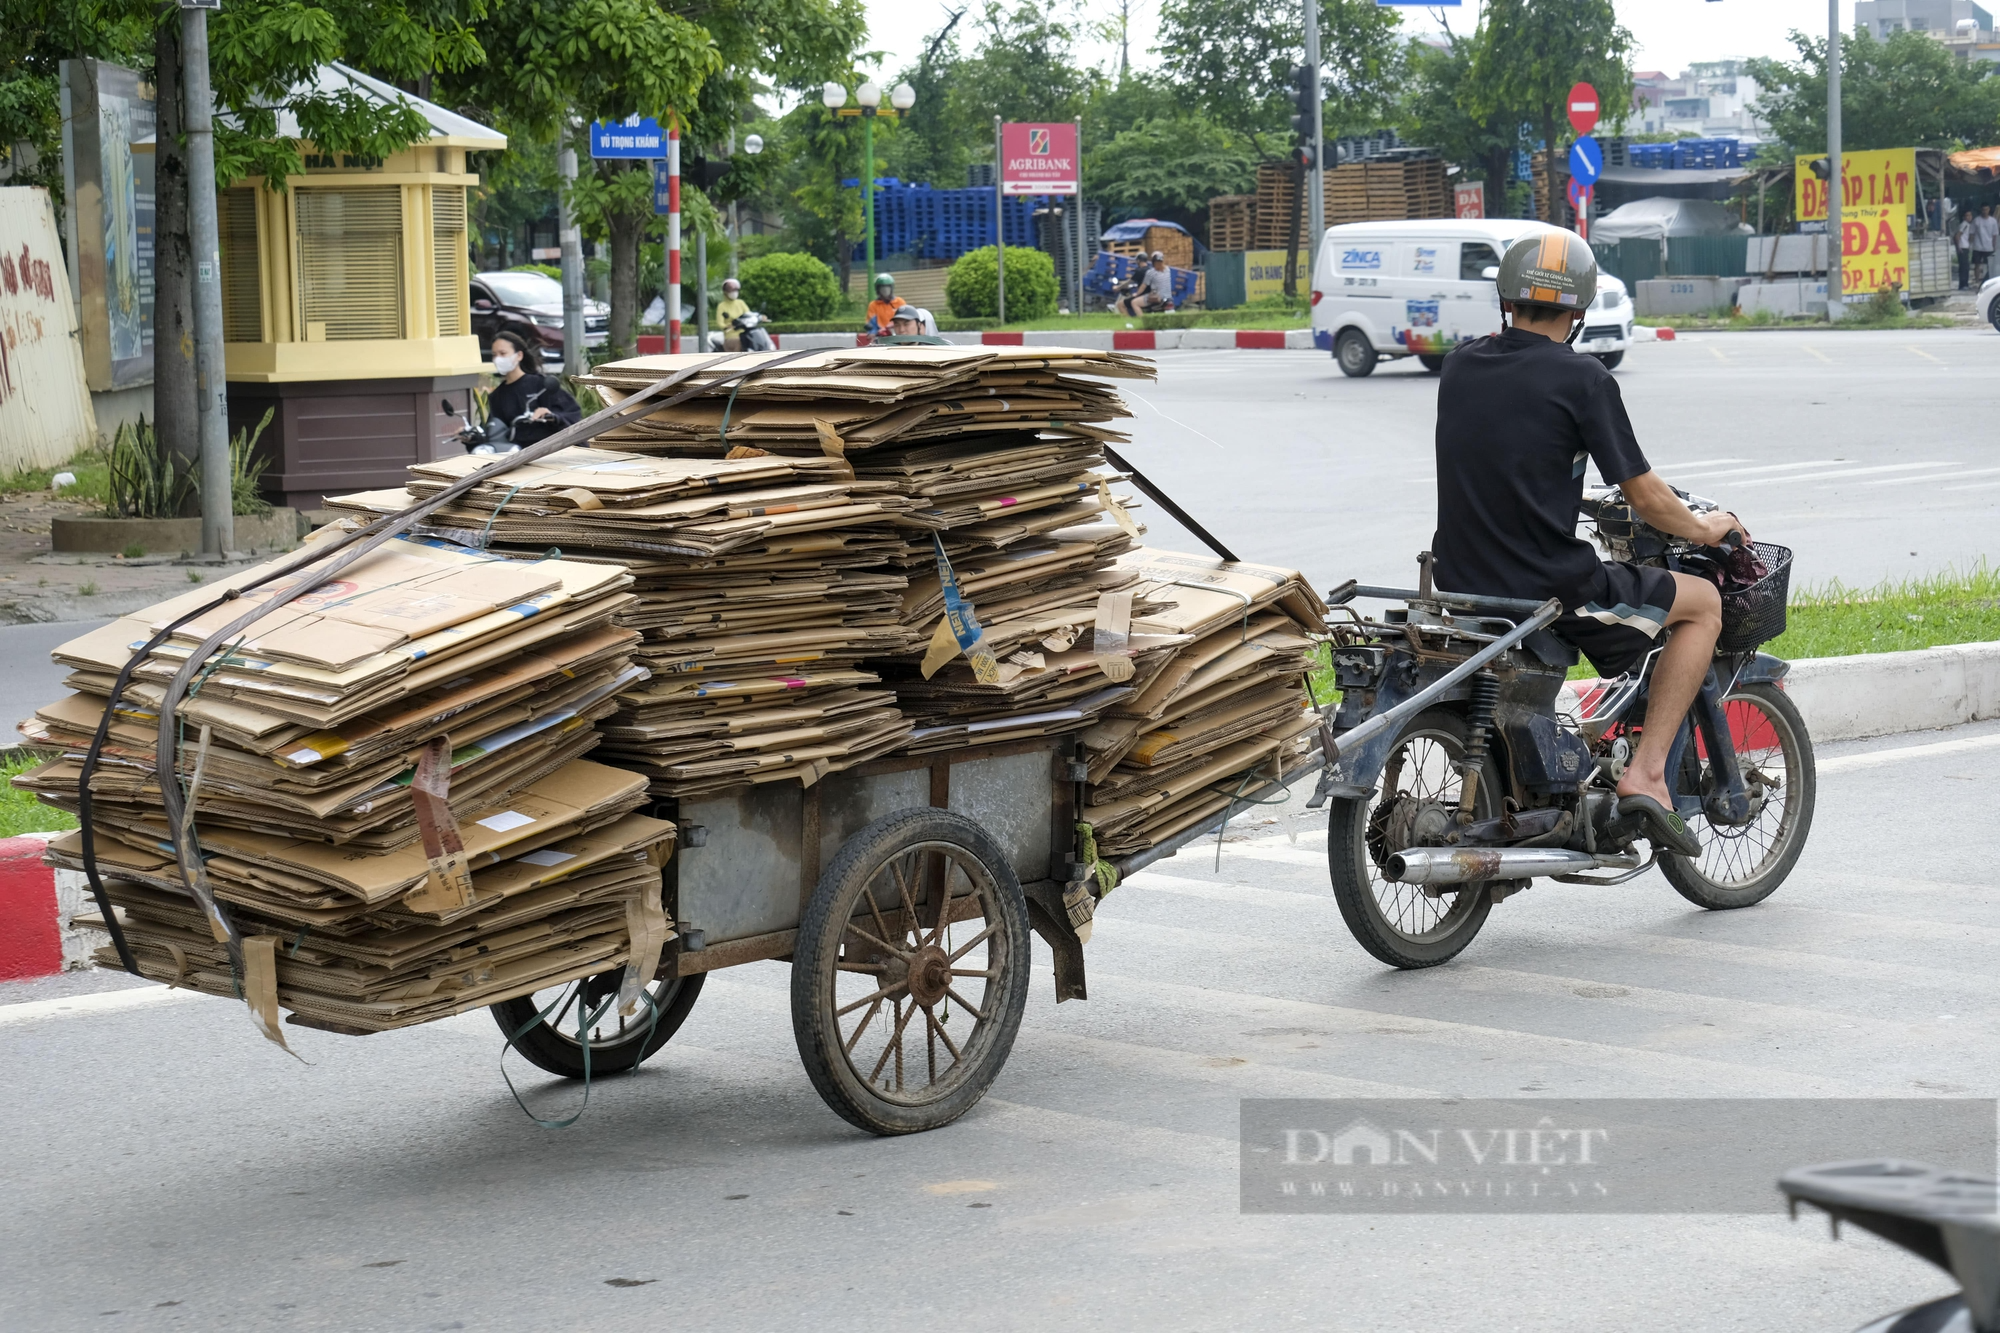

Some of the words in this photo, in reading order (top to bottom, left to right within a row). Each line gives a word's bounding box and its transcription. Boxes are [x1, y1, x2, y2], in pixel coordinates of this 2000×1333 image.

[611, 136, 634, 150] TRỌNG
[636, 133, 659, 148] KHÁNH
[1008, 159, 1071, 171] AGRIBANK
[1842, 209, 1901, 257] ĐÁ
